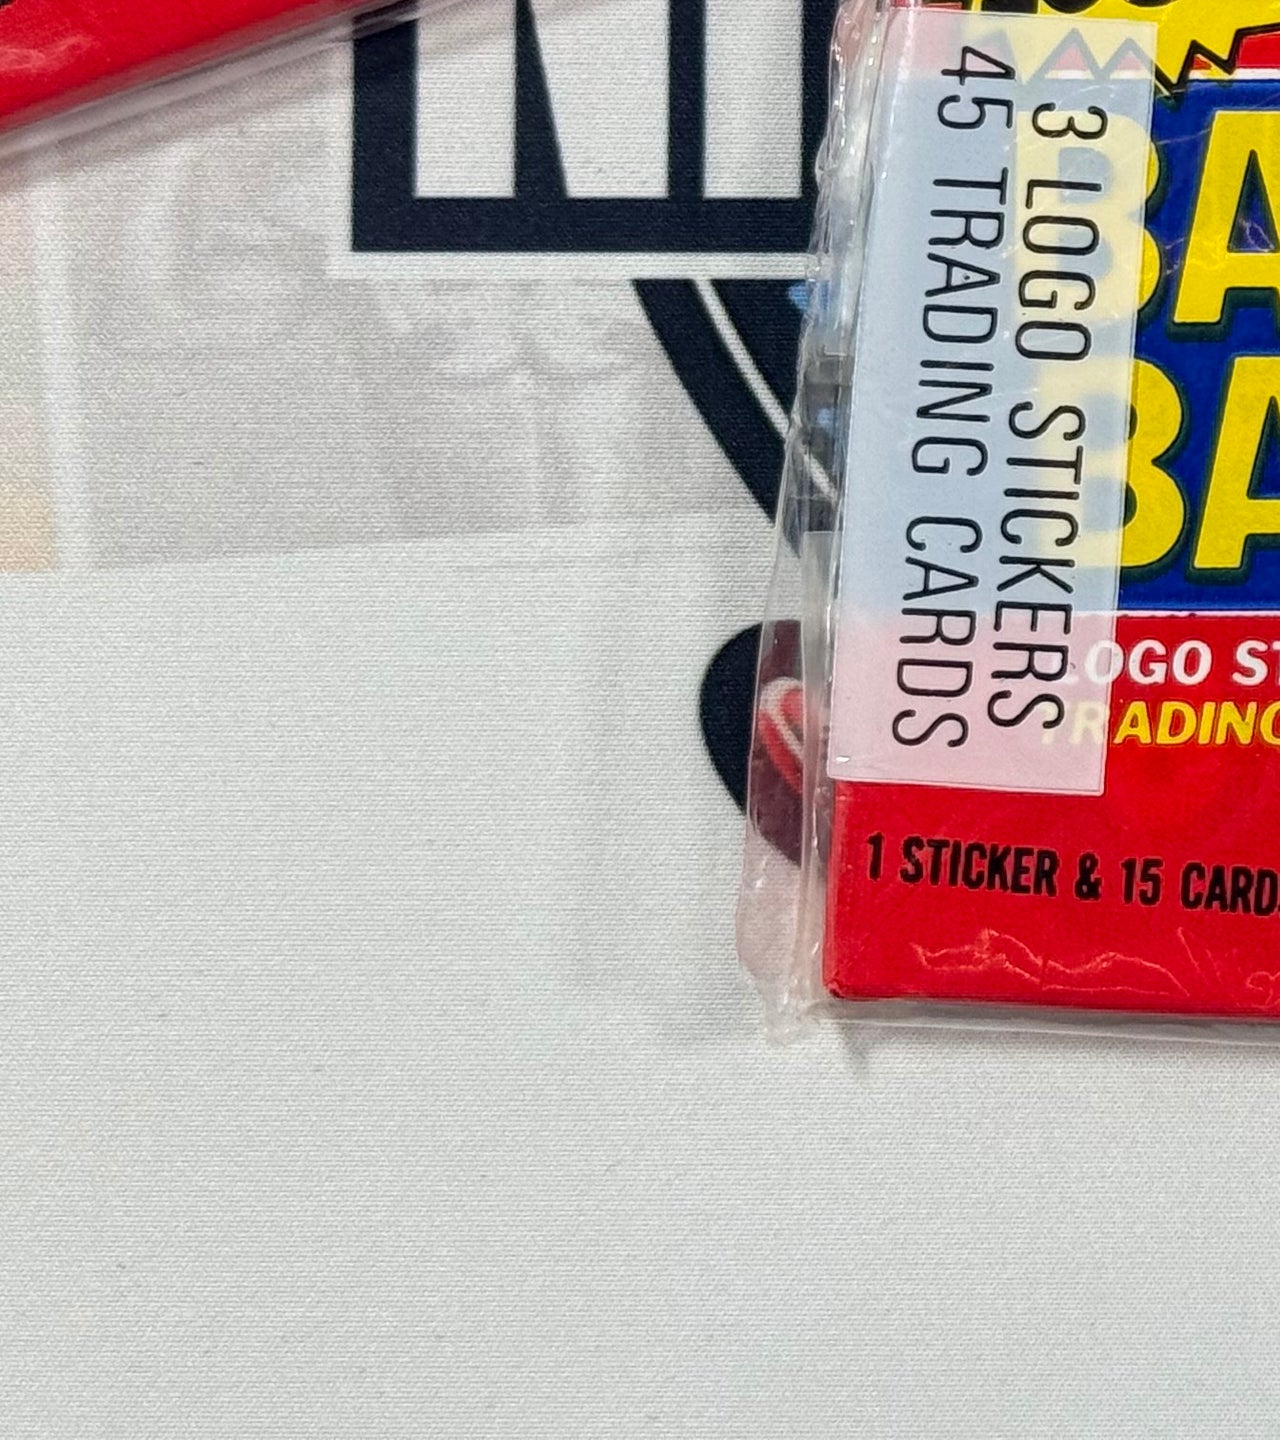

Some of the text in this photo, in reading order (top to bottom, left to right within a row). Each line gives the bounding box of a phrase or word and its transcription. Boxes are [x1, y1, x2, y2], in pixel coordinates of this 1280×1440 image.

[892, 46, 1015, 748] 45 TRADING CARDS
[988, 103, 1108, 729] 3 LOGO STICKERS
[1054, 639, 1212, 686] OGO
[866, 833, 885, 881] 1
[901, 836, 1058, 897] STICKER
[1075, 854, 1101, 901] &
[1121, 859, 1163, 905] 15
